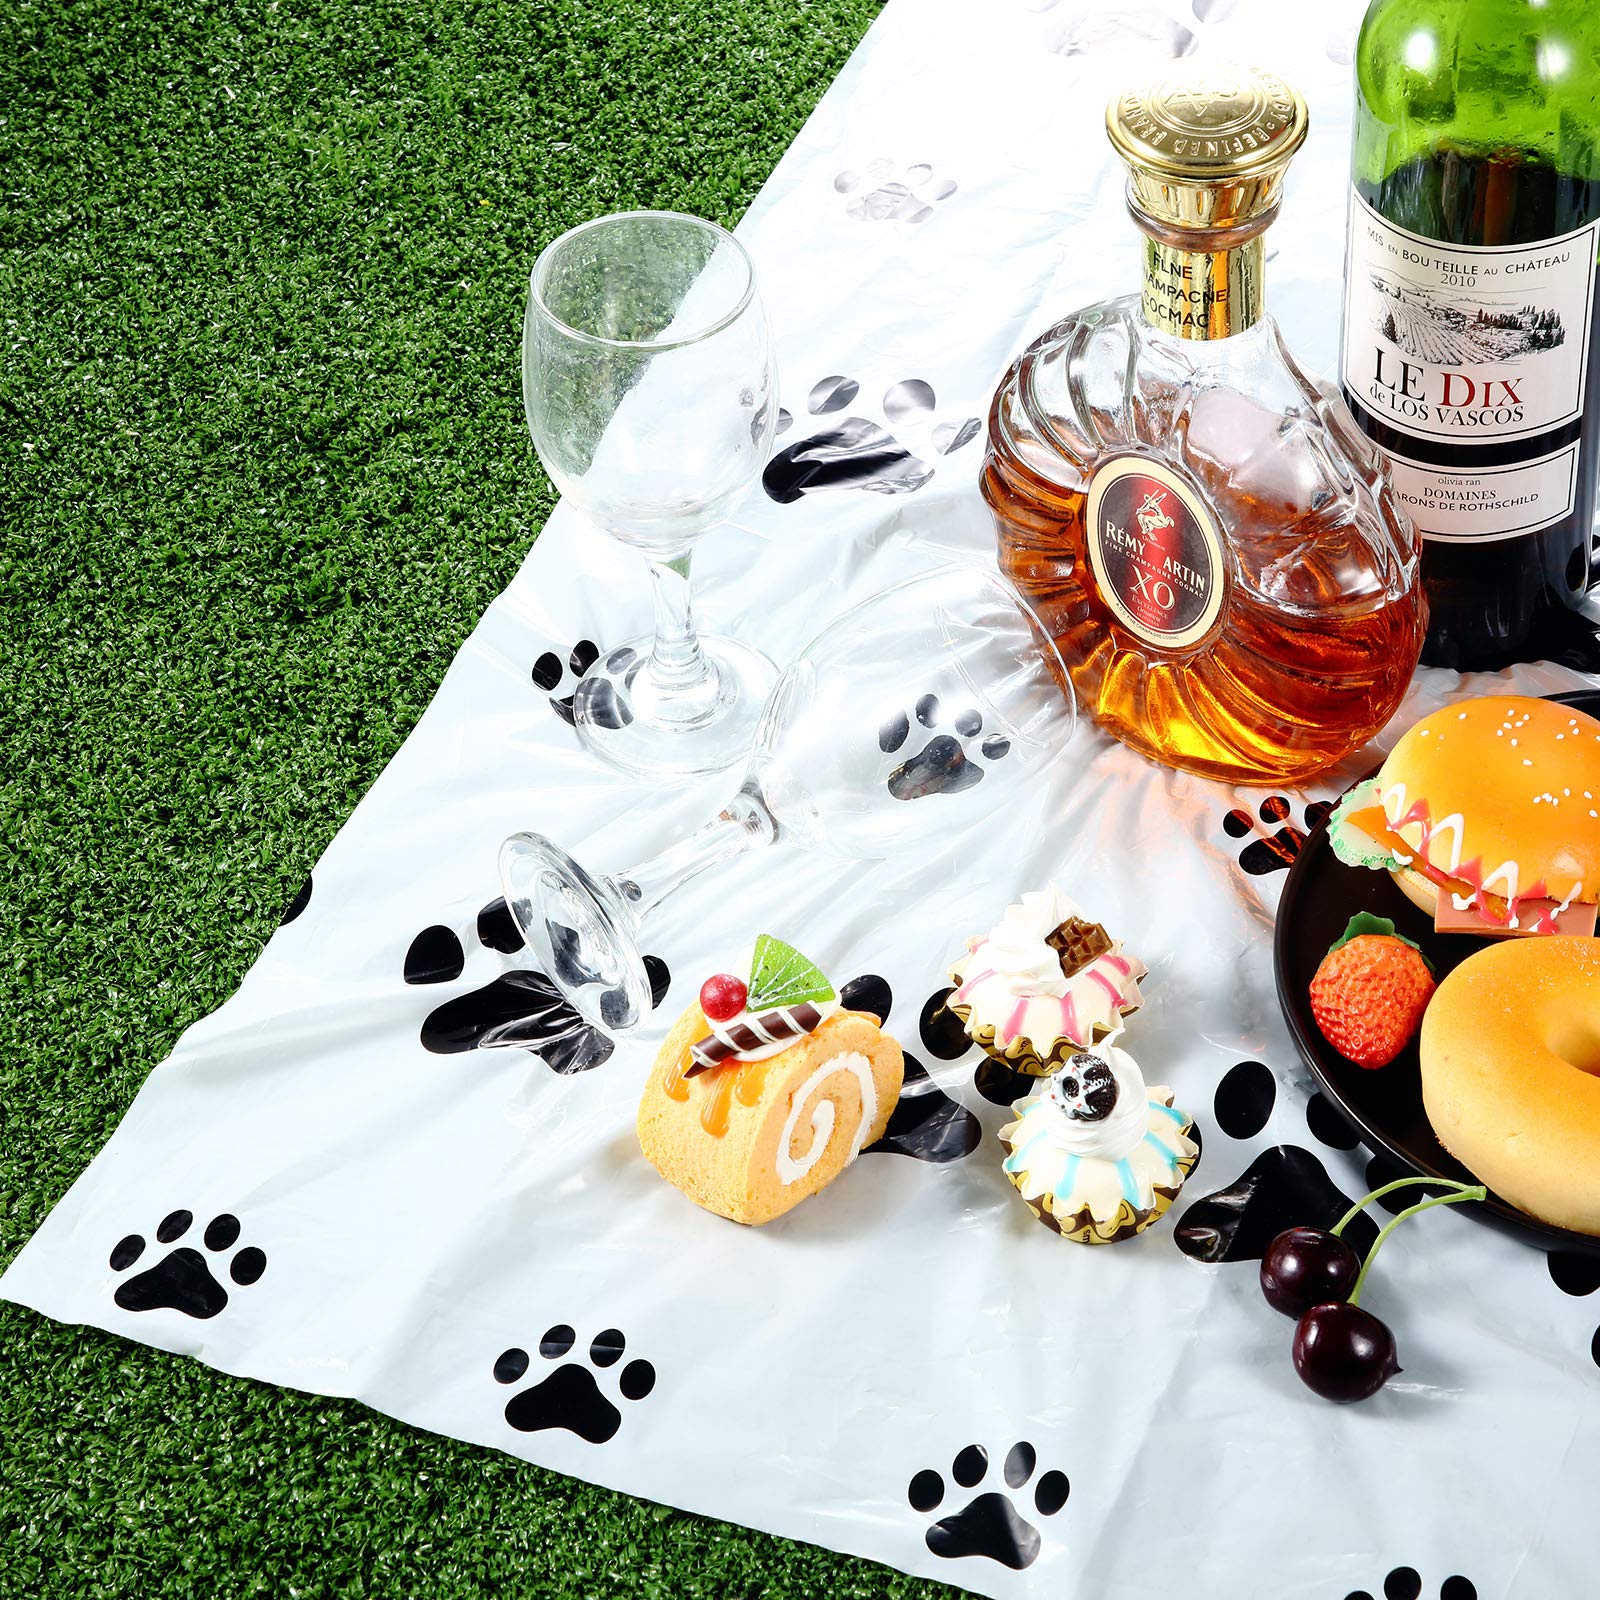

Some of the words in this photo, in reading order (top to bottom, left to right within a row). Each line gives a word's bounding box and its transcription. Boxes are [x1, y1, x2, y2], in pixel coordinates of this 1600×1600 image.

[1367, 226, 1384, 246] MIS
[1387, 243, 1398, 255] EN
[1484, 267, 1498, 276] AU
[1505, 251, 1571, 275] CHÂTEAU
[1440, 273, 1476, 288] 2010
[1373, 347, 1426, 402] LE
[1370, 383, 1386, 404] de
[1390, 396, 1429, 422] LOS
[1435, 405, 1525, 427] VASCOS
[1423, 486, 1497, 501] DOMAINES
[1437, 476, 1463, 486] olivia
[1465, 478, 1481, 486] ran
[1439, 501, 1455, 511] DE
[1459, 493, 1539, 512] ROTHSCHILD
[1105, 520, 1146, 556] RÉMY
[1163, 556, 1206, 592] ARTIN
[1105, 540, 1123, 553] FINE
[1125, 550, 1172, 580] CHAMPAGNE
[1174, 577, 1204, 599] COGNAC
[1130, 564, 1175, 610] XO
